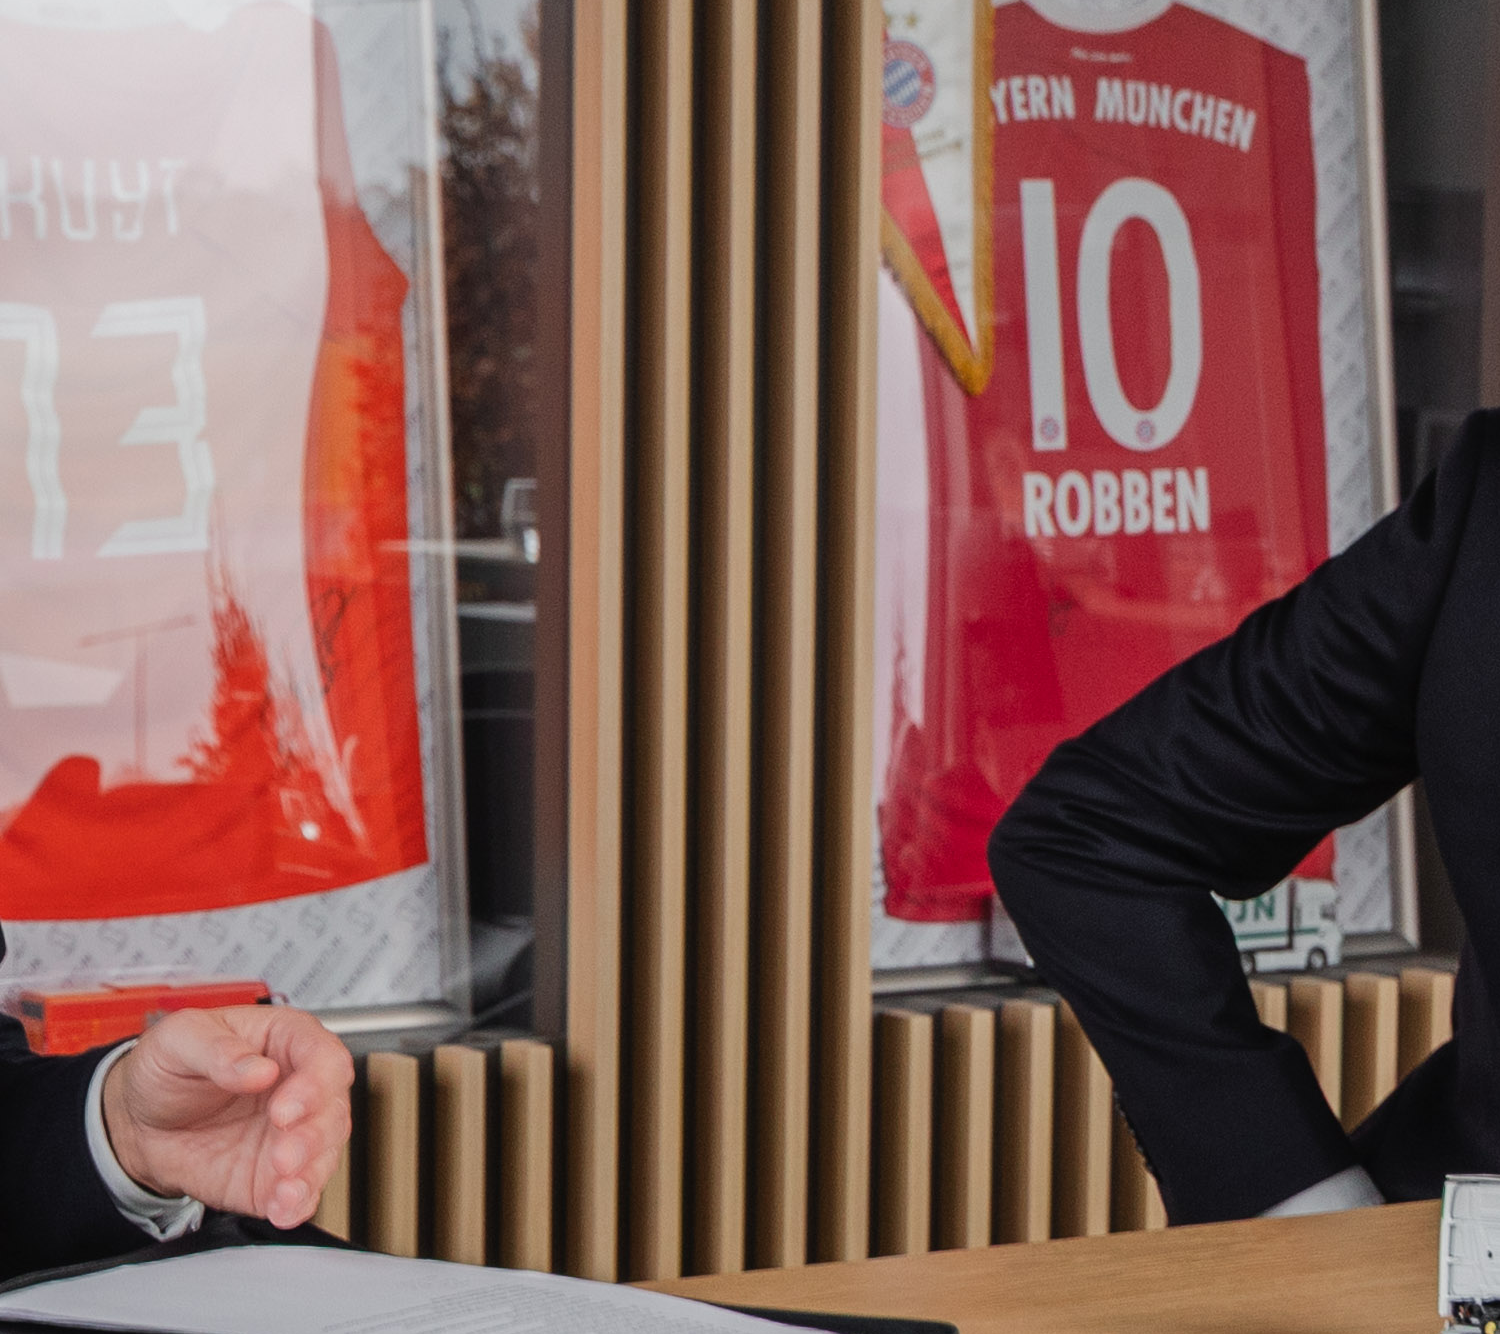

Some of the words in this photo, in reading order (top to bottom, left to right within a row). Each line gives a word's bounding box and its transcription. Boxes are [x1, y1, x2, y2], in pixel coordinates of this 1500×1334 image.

[990, 73, 1077, 125] YERN
[1019, 176, 1204, 453] 10
[1022, 466, 1210, 538] ROBBEN
